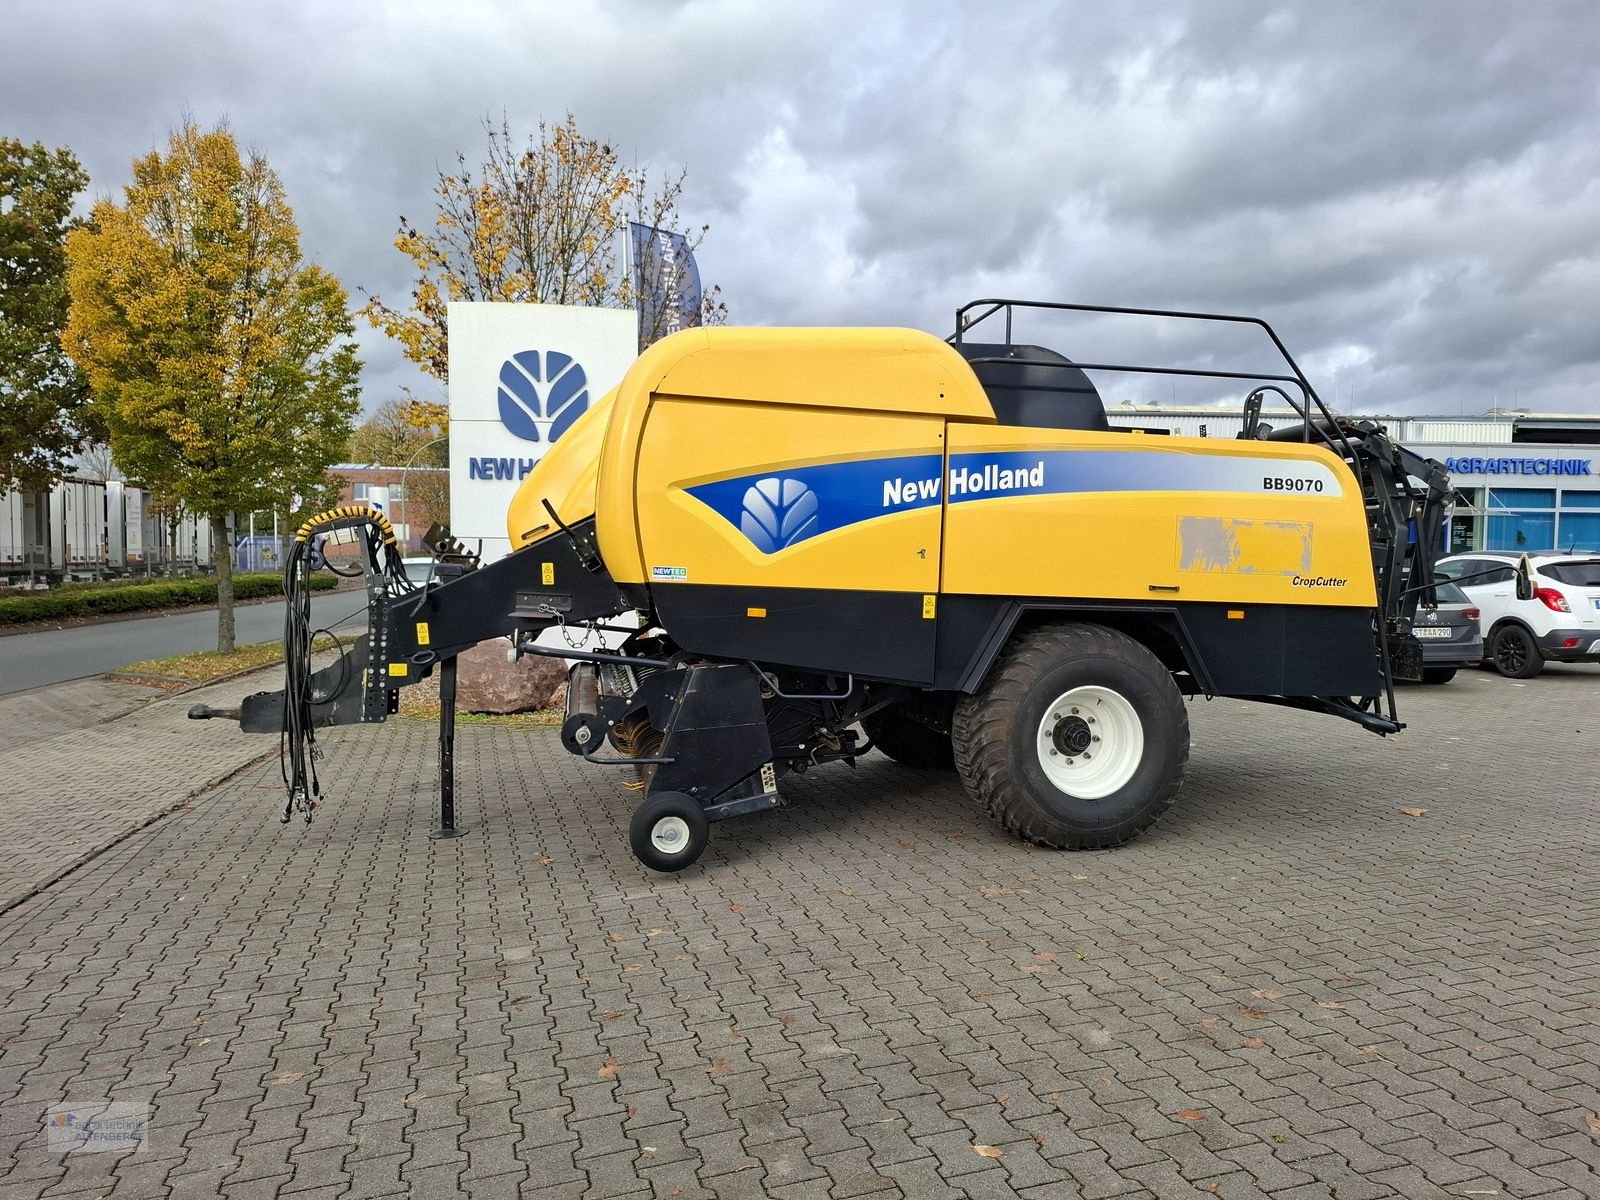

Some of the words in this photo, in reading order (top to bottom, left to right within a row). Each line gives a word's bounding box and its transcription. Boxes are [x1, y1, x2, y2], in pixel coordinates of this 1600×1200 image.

[666, 307, 680, 336] EW
[469, 457, 515, 480] NEW
[1445, 457, 1592, 475] AGRARTECHNIK
[883, 478, 940, 506] New
[950, 461, 1043, 495] Holland
[1263, 477, 1324, 492] BB9070
[1292, 576, 1347, 588] CropCutter
